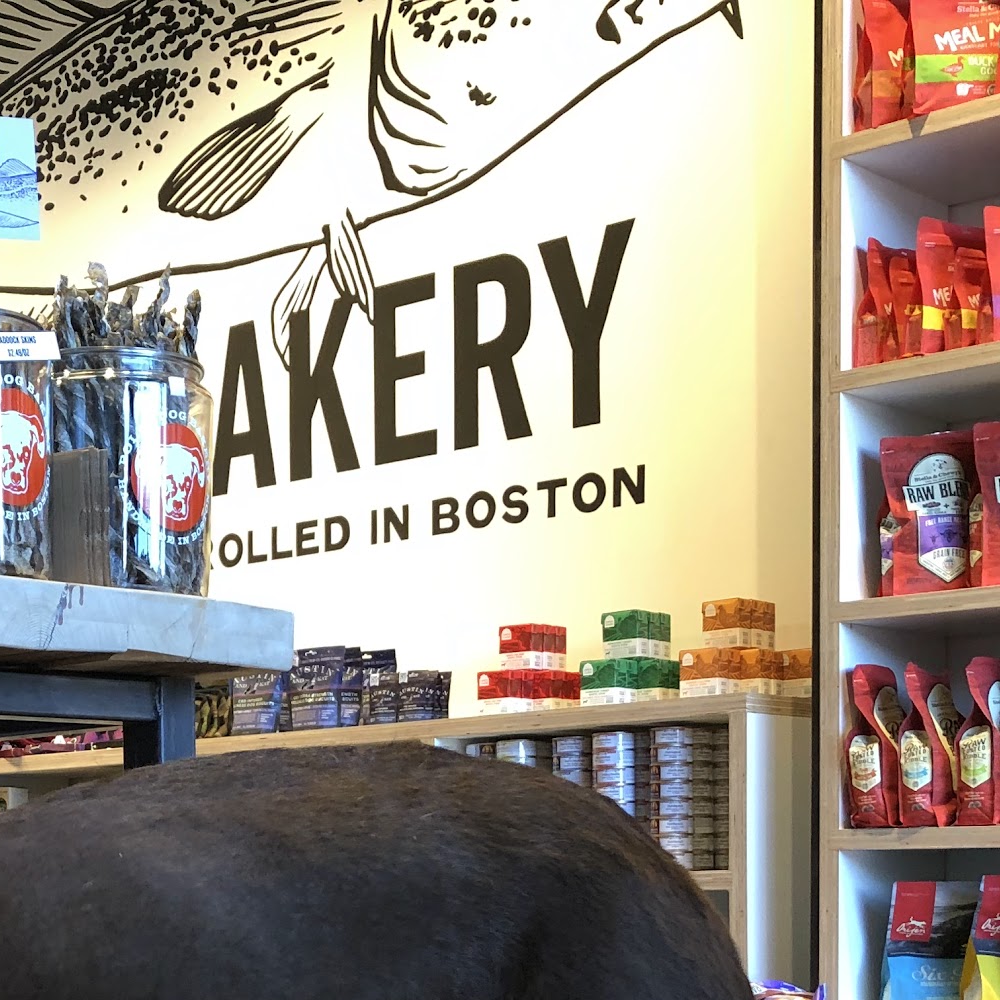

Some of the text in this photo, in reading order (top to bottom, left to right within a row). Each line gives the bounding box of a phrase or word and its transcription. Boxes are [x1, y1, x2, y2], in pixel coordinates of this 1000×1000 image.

[934, 25, 986, 52] MEAL
[21, 336, 36, 344] SKINS
[212, 218, 636, 497] AKERY
[906, 486, 936, 504] RAW
[18, 510, 30, 521] IN
[210, 464, 646, 570] OLLED IN BOSTON
[933, 549, 966, 560] GRAIN FREE
[370, 690, 396, 698] AUSTIN
[400, 686, 424, 696] AUSTIN
[896, 922, 926, 938] Orijen
